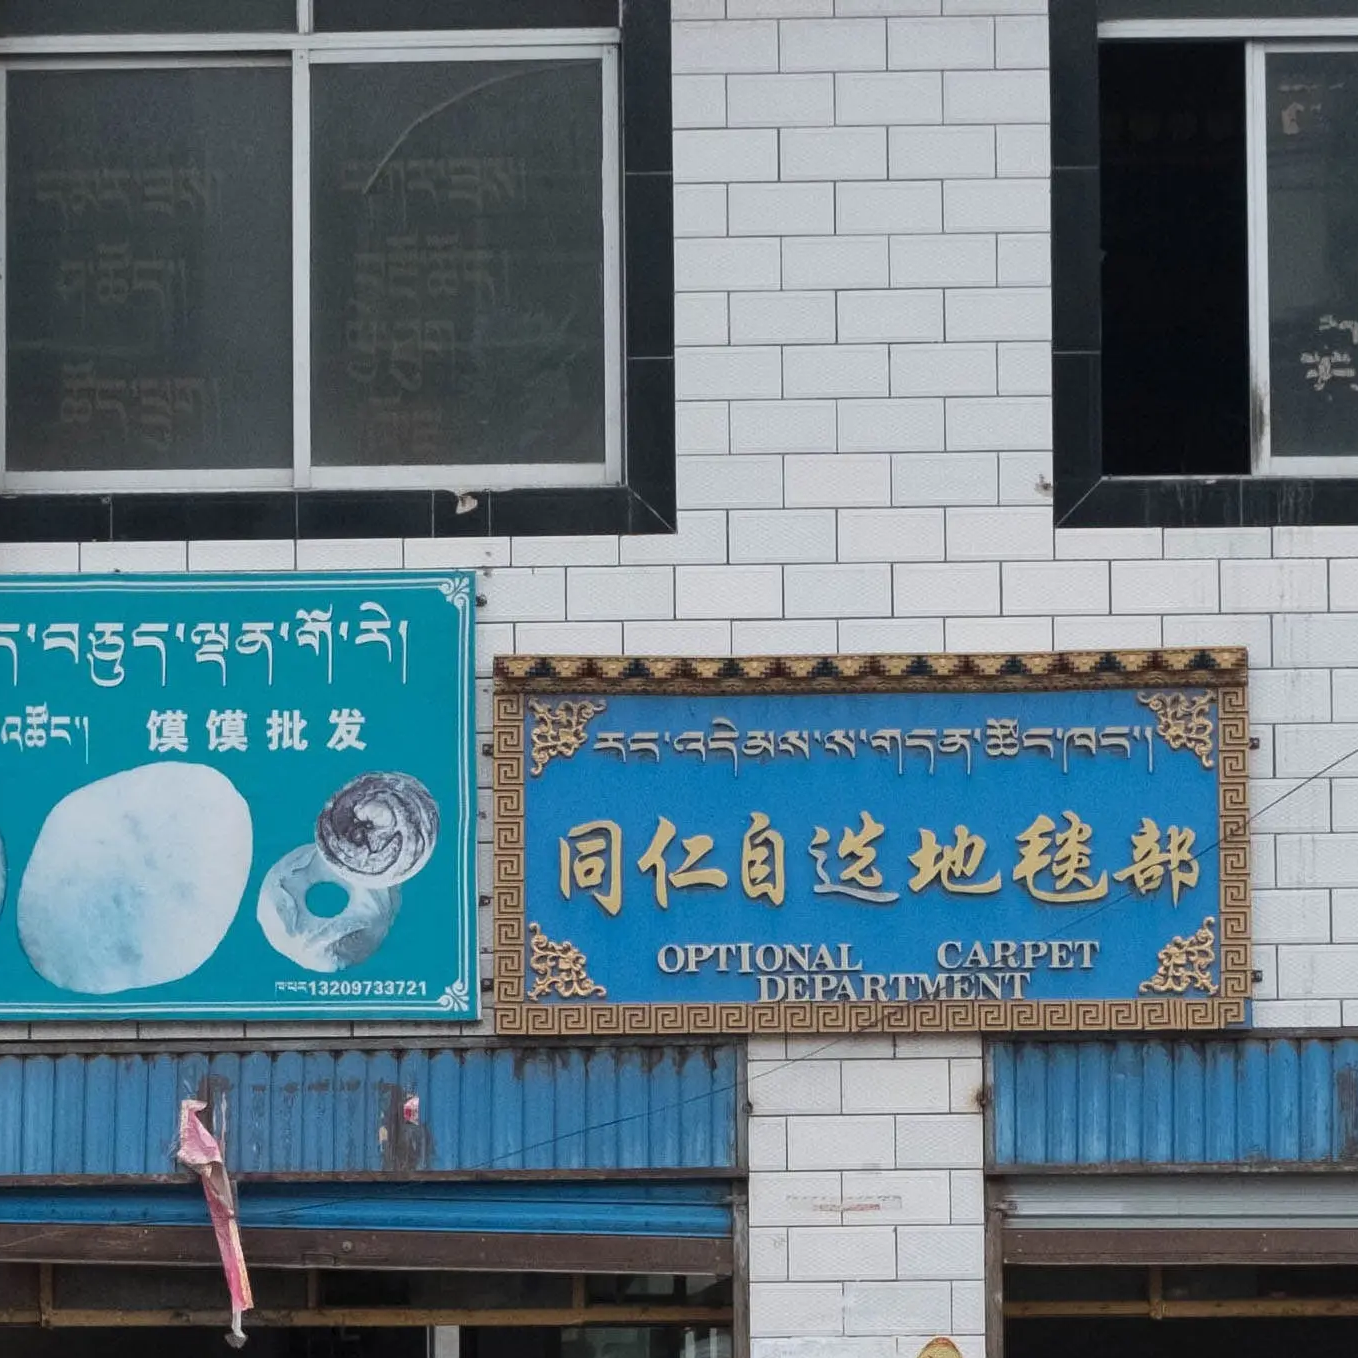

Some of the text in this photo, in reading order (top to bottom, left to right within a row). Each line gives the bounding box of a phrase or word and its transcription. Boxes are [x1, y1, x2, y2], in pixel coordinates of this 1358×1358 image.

[146, 708, 369, 754] 馍馍批发
[559, 810, 1199, 915] 同仁自选地毯部
[657, 940, 1101, 974] OPTIONAL CARPET
[755, 971, 1032, 1002] DEPARTMENT
